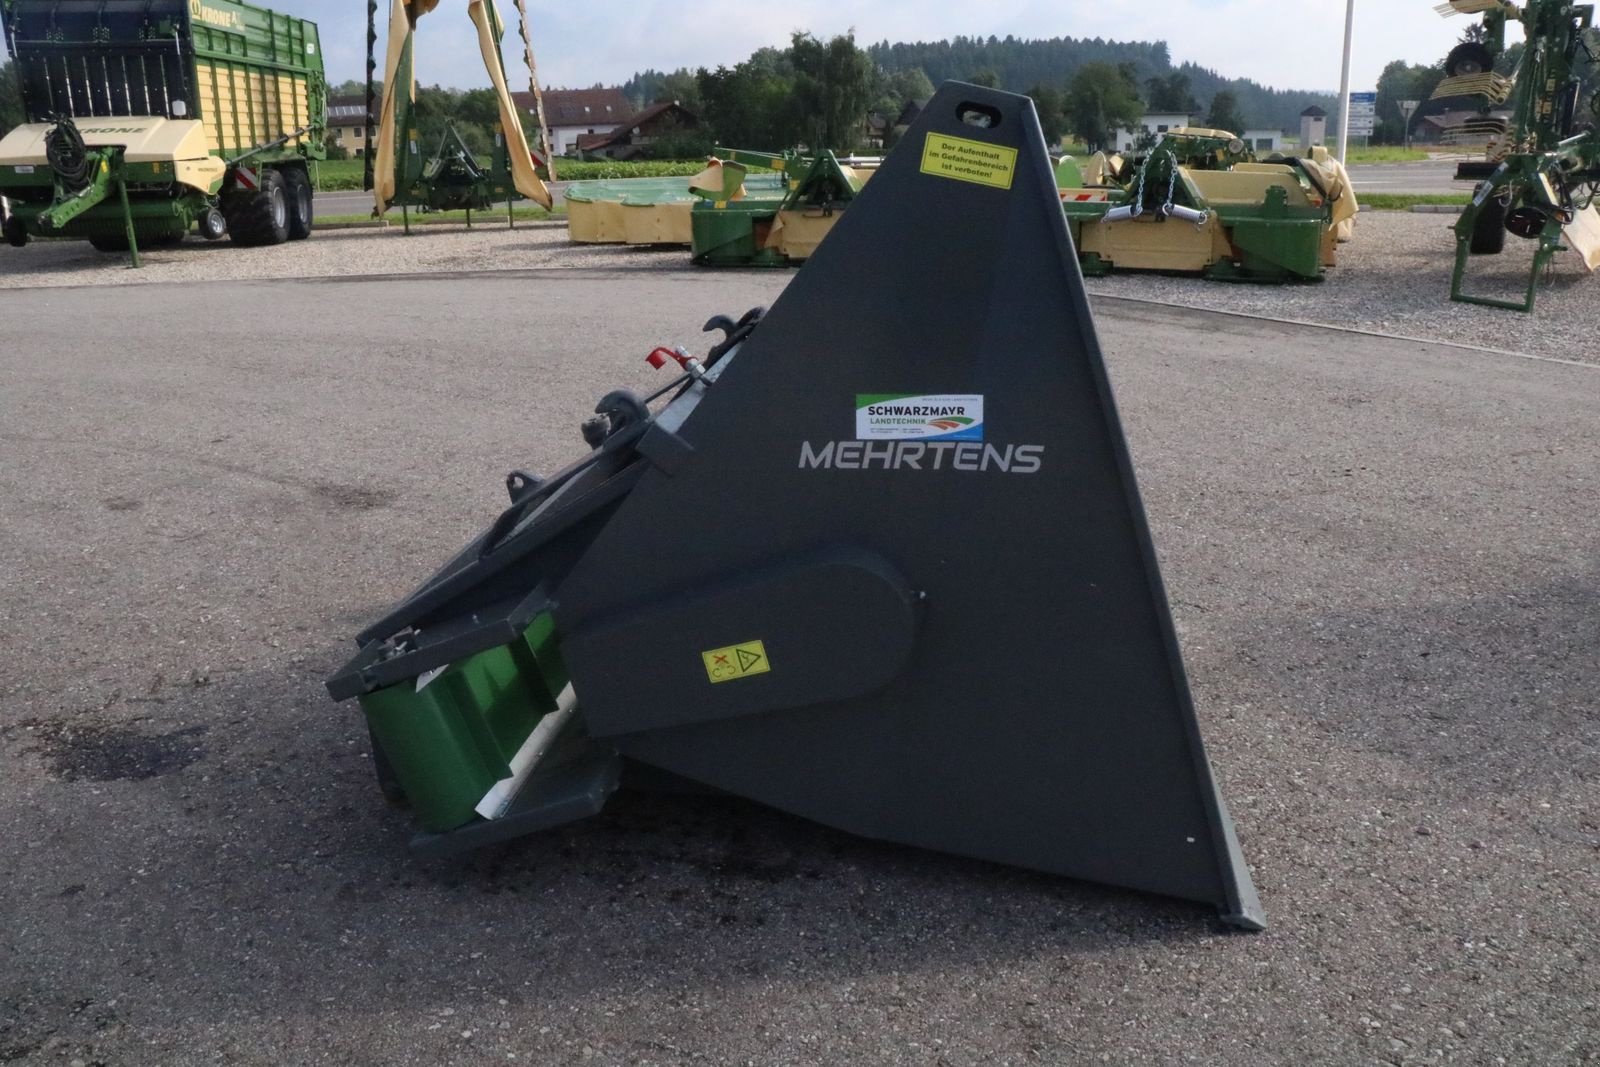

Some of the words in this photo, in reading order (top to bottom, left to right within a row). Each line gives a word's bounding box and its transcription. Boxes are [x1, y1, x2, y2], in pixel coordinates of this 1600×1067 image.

[201, 6, 231, 27] KRONE
[941, 143, 956, 151] Der
[958, 146, 1000, 160] Aufenthalt
[941, 153, 1009, 171] Gefahrenbereich
[941, 162, 952, 170] ist
[954, 166, 993, 178] verboten!
[868, 406, 965, 416] SCHWARZMAYR
[798, 440, 1045, 473] MEHRTENS
